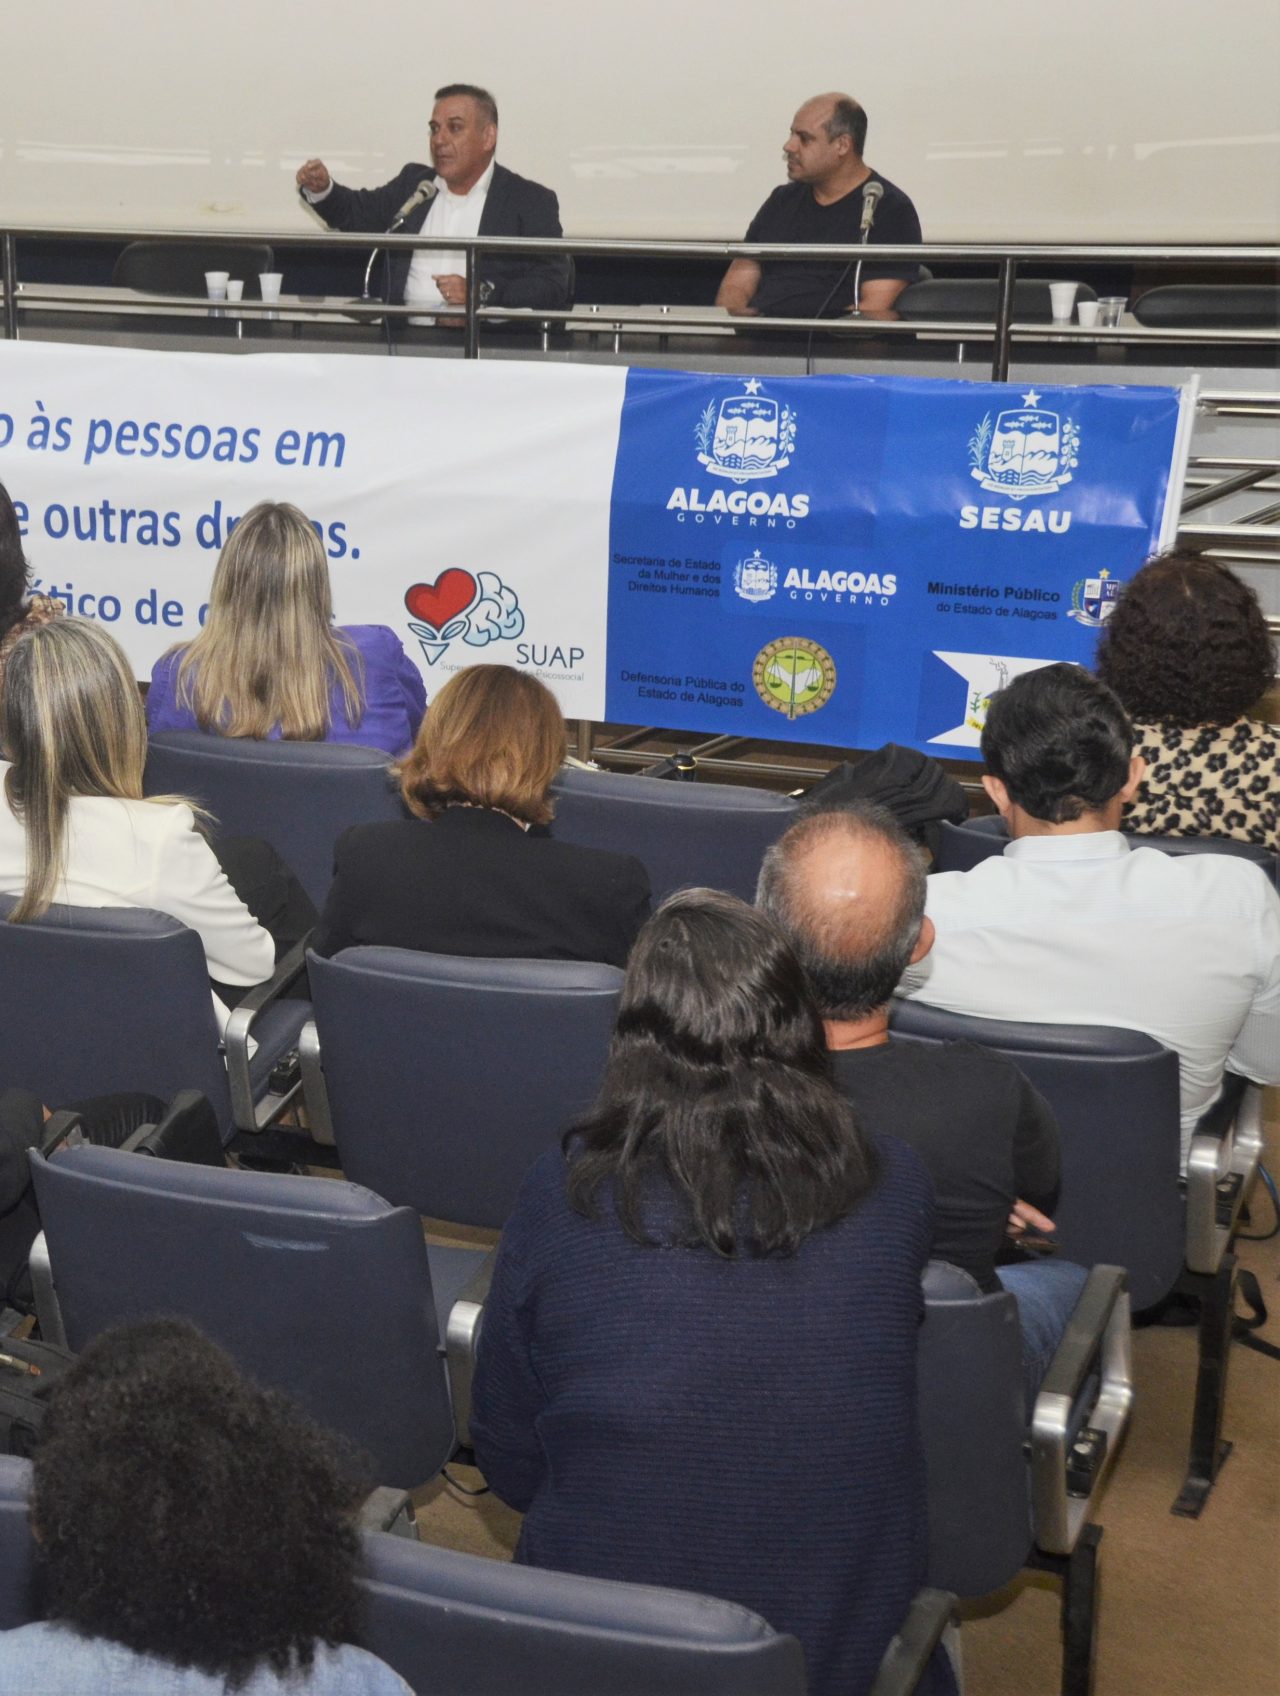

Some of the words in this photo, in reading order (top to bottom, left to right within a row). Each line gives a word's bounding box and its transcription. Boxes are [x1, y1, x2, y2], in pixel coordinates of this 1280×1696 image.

[27, 400, 73, 452] às
[84, 419, 261, 466] pessoas
[274, 429, 347, 468] em
[666, 487, 810, 518] ALAGOAS
[43, 499, 181, 549] outras
[677, 512, 797, 529] GOVERNO
[959, 504, 1072, 534] SESAU
[613, 553, 666, 567] Secretaria
[668, 558, 681, 568] de
[684, 558, 721, 570] Estado
[638, 568, 651, 579] da
[654, 570, 690, 582] Mulher
[702, 574, 721, 585] dos
[783, 568, 897, 596] ALAGOAS
[628, 580, 667, 593] Direitos
[670, 584, 720, 598] Humanos
[790, 590, 889, 606] GOVERNO
[927, 581, 1000, 599] Ministério
[1004, 584, 1061, 603] Público
[134, 588, 184, 628] de
[936, 602, 950, 613] do
[953, 603, 992, 616] Estado
[995, 606, 1010, 617] de
[1013, 608, 1058, 622] Alagoas
[516, 643, 585, 669] SUAP
[621, 670, 682, 686] Defensoria
[684, 675, 727, 691] Pública
[730, 680, 745, 692] do
[638, 686, 677, 700] Estado
[680, 690, 694, 702] de
[697, 692, 744, 707] Alagoas
